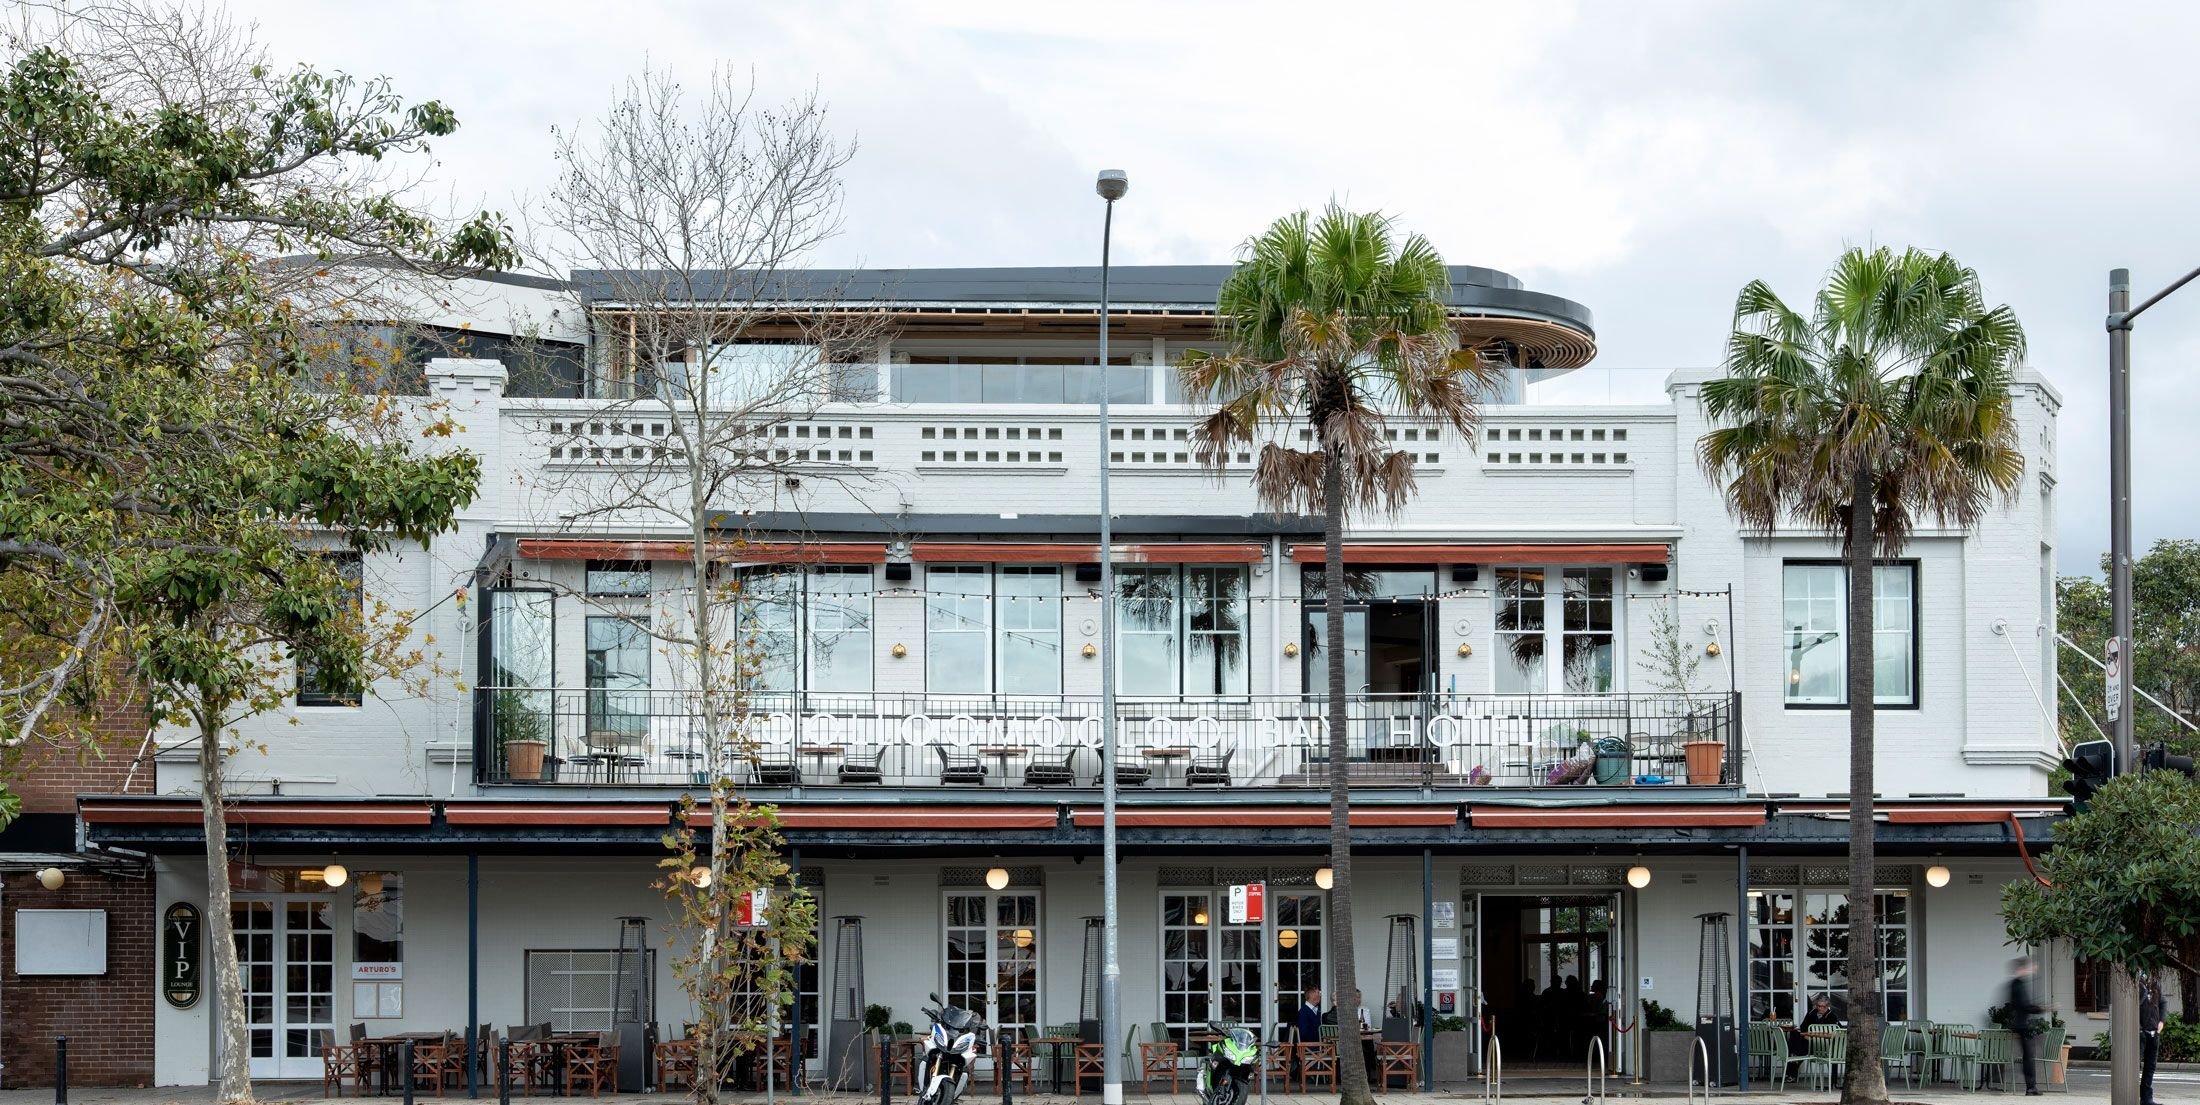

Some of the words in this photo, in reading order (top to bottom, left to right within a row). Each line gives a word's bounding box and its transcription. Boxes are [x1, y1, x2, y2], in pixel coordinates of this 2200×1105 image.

[1390, 714, 1534, 747] HOTEL
[1235, 887, 1241, 896] P
[174, 921, 191, 979] VIP
